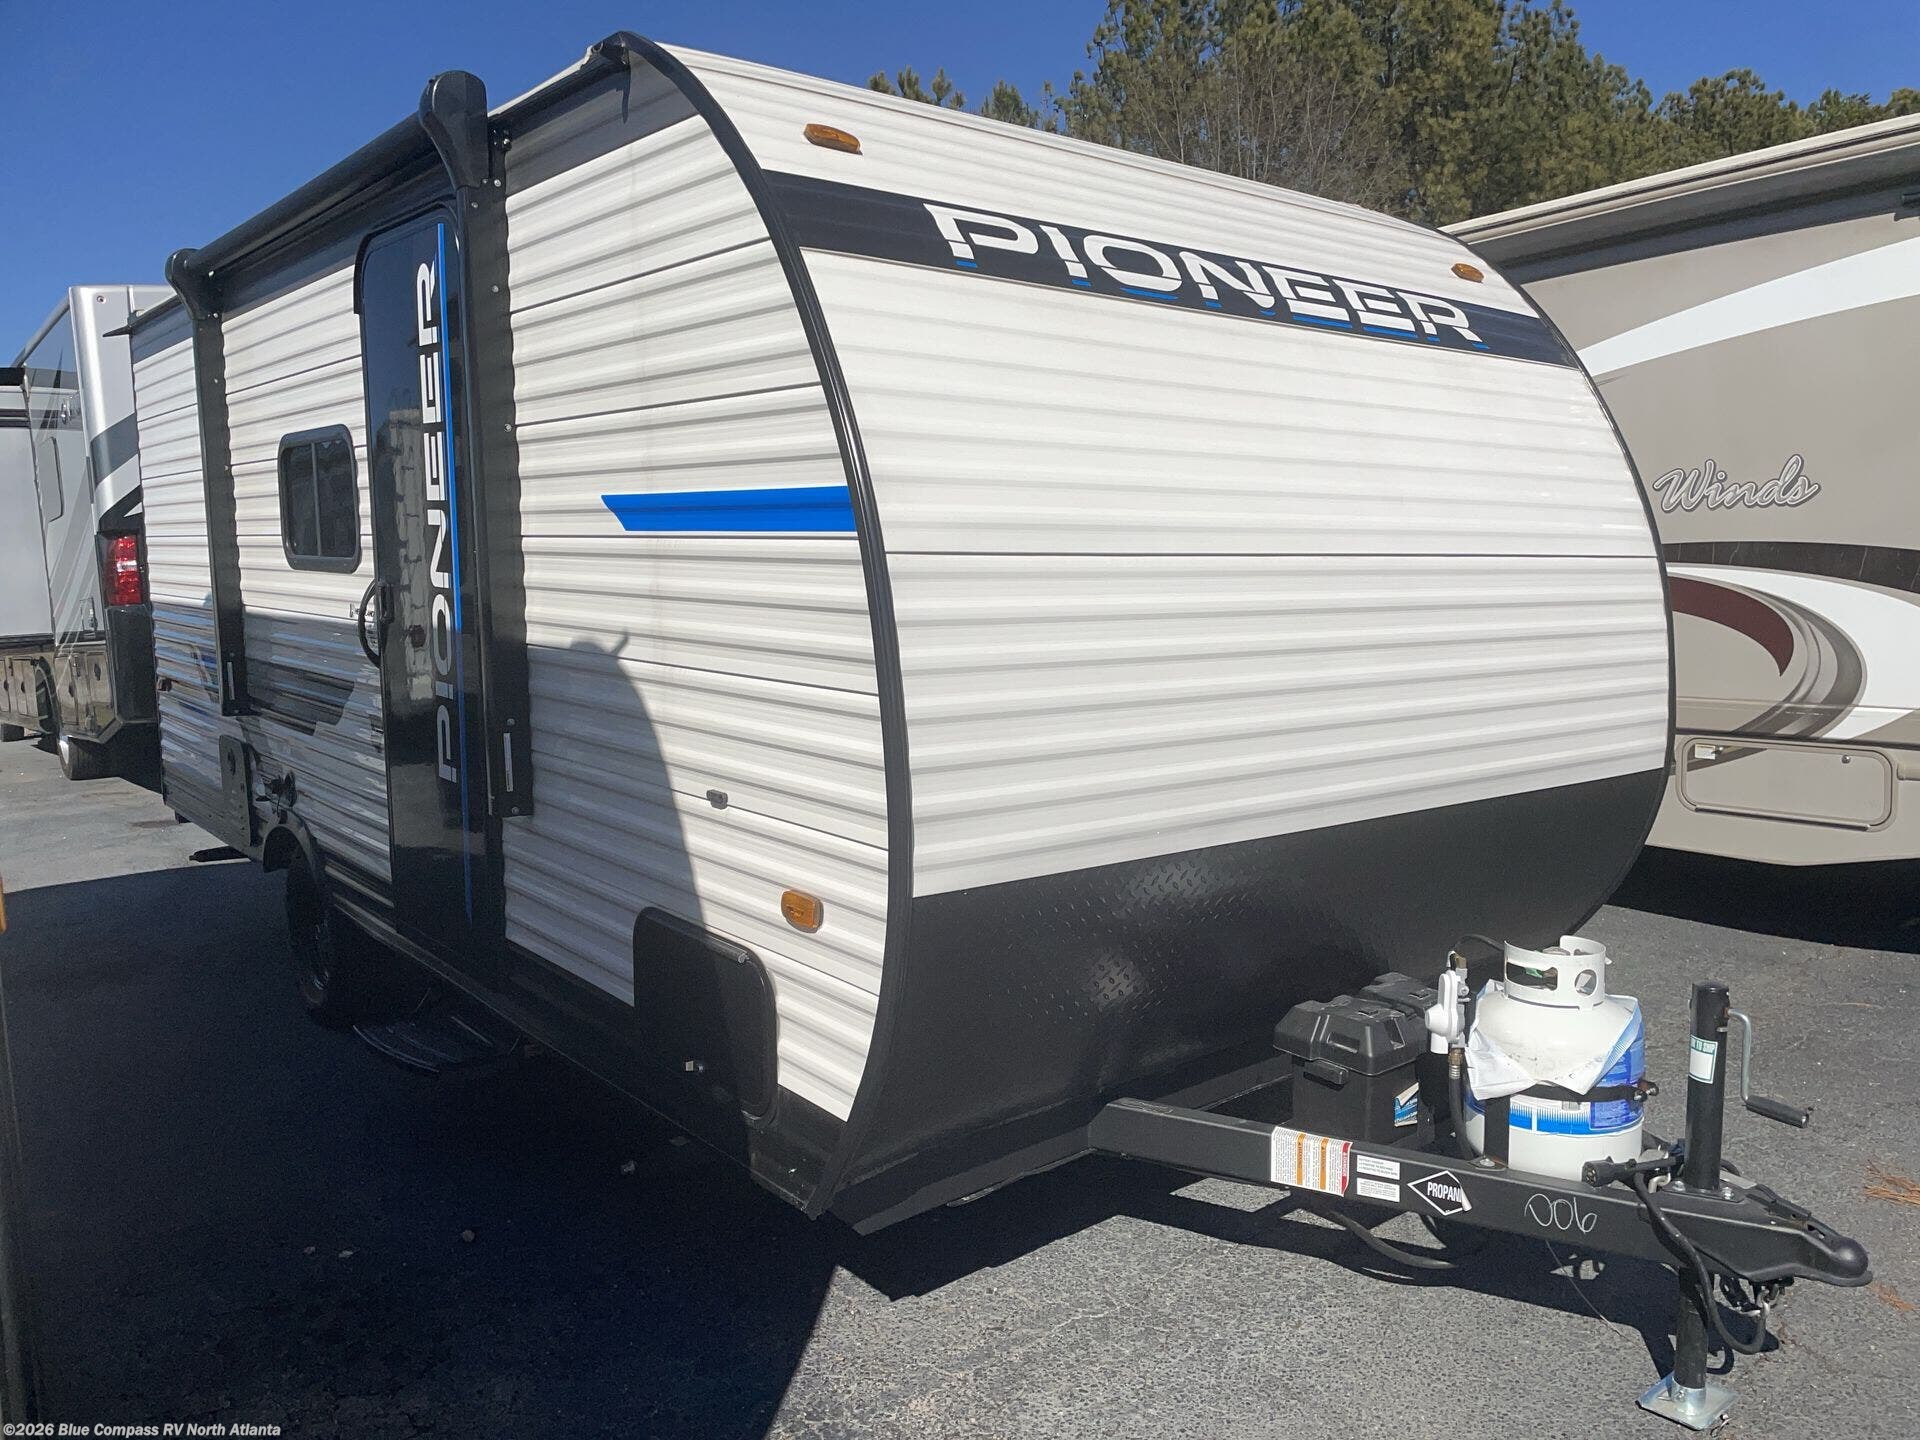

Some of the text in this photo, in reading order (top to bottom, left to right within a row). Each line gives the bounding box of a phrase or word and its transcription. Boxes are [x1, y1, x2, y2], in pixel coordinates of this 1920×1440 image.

[923, 203, 1487, 347] PIONEER
[416, 259, 457, 784] PIONEER
[1653, 453, 1821, 513] Winds
[1427, 1181, 1462, 1203] PROPAN
